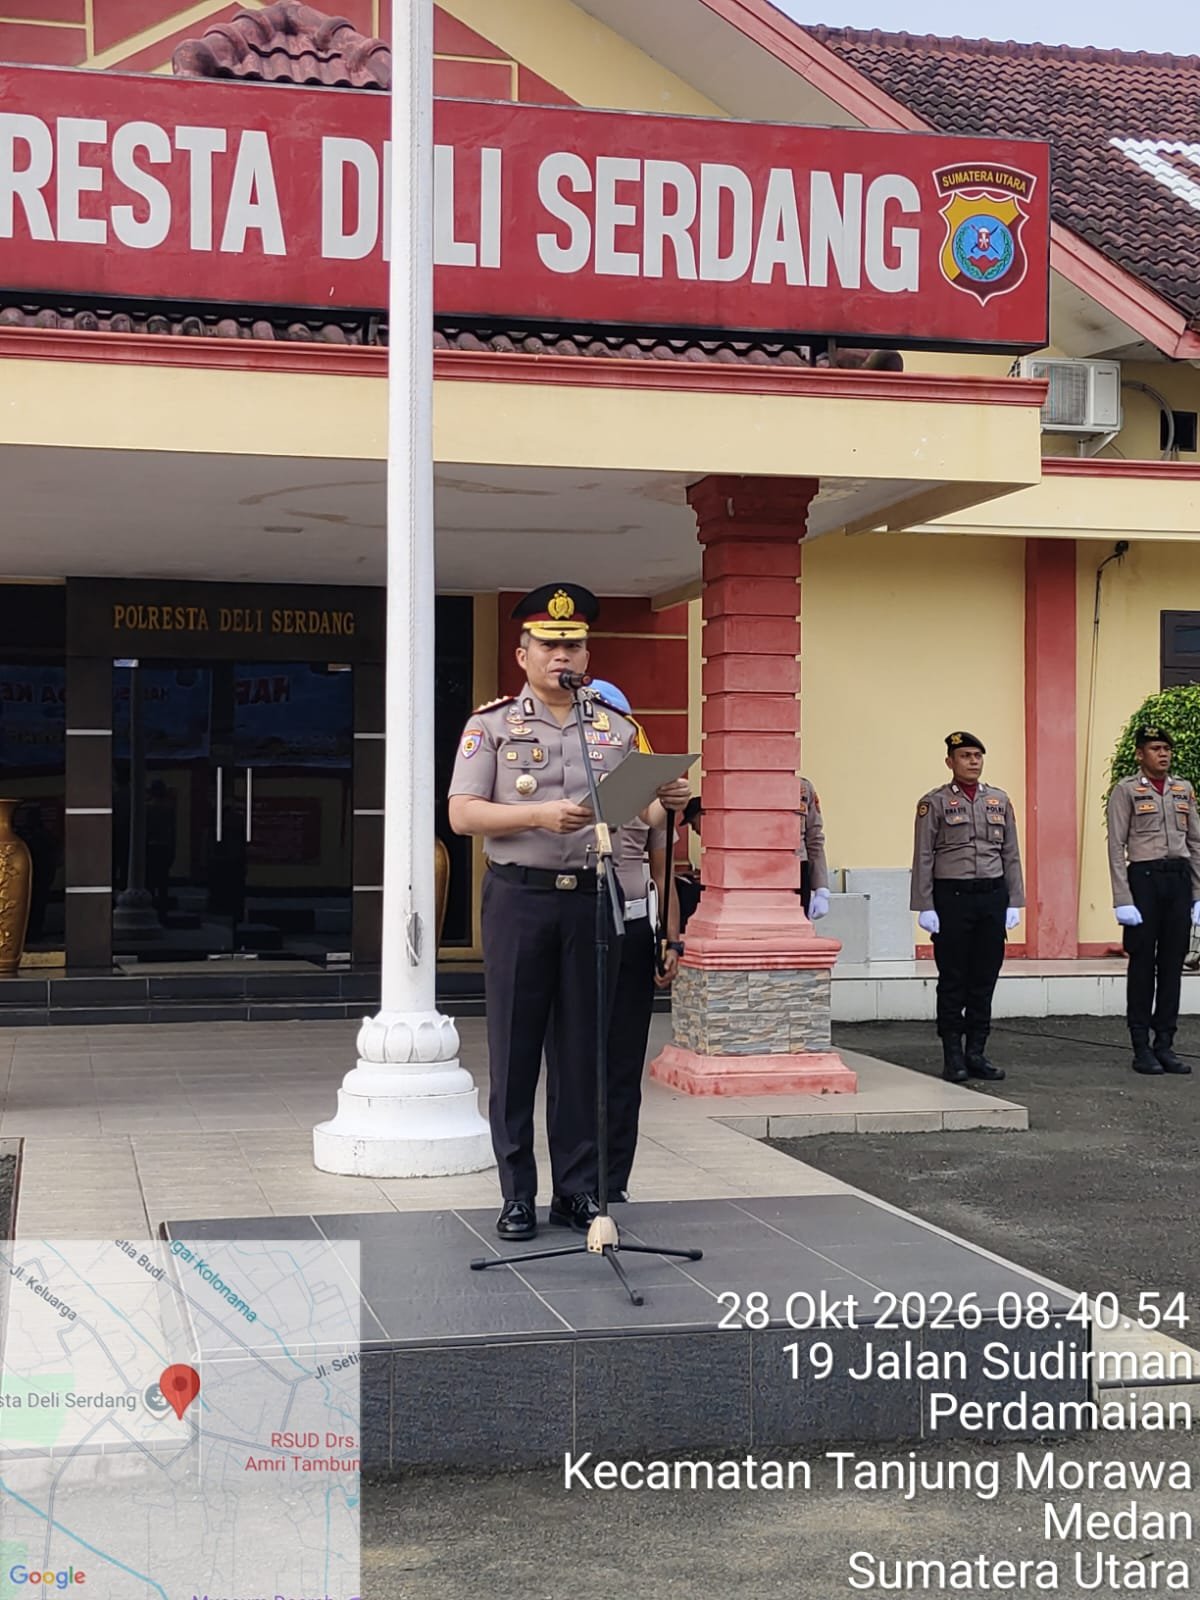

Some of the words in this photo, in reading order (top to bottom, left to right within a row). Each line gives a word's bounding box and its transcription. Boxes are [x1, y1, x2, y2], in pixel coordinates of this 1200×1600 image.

[942, 171, 993, 187] SUMATERA
[996, 173, 1026, 192] UTARA
[0, 112, 286, 256] RESTA
[321, 136, 501, 269] DLI
[536, 152, 921, 293] SERDANG
[113, 605, 209, 631] POLRESTA
[219, 608, 263, 632] DELI
[272, 609, 354, 635] SERDANG
